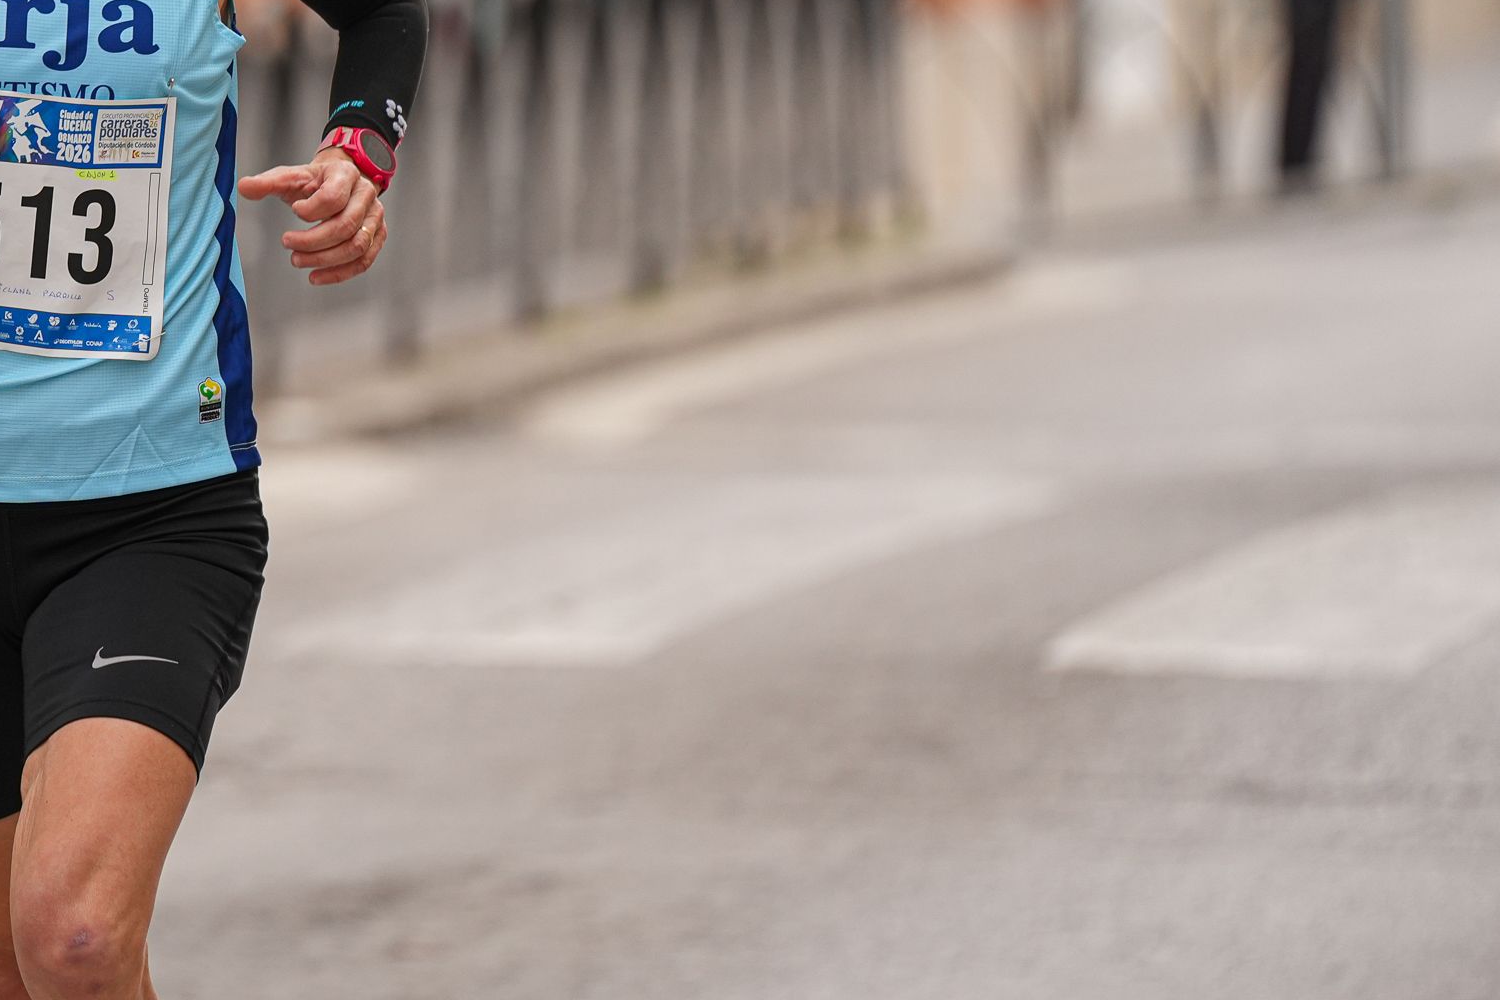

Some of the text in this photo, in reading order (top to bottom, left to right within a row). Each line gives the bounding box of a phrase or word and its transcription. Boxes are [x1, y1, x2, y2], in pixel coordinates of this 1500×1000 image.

[60, 109, 94, 120] Ciudad de
[59, 119, 92, 132] LUCENA
[100, 119, 150, 129] carreras
[99, 125, 157, 141] populares
[56, 142, 92, 163] 2026
[110, 170, 115, 178] 1
[142, 288, 150, 313] TIEMPO
